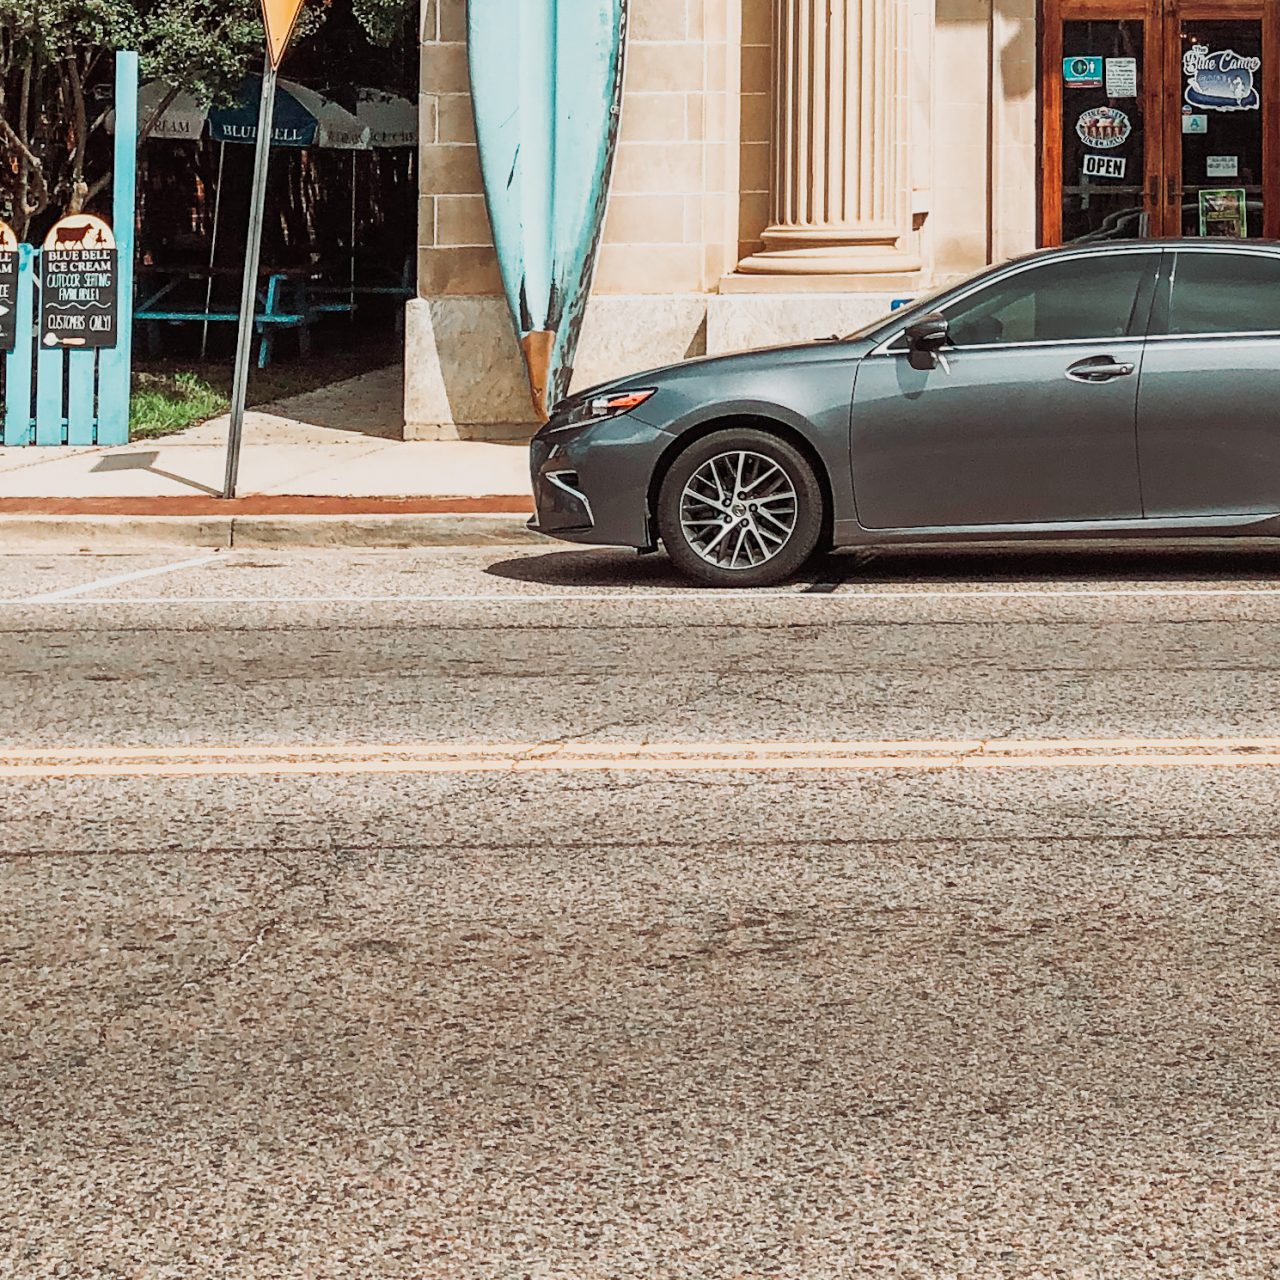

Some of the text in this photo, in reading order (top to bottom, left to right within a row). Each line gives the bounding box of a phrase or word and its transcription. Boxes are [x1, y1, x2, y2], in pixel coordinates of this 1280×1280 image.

[1184, 51, 1260, 75] Blue Canoe
[1190, 118, 1200, 128] A
[1086, 157, 1123, 176] OPEN
[48, 250, 110, 261] BLUE BELL
[48, 261, 112, 273] ICE CREAM
[46, 273, 112, 288] OUTDOOR SEATING
[47, 314, 86, 330] CUSTOMERS
